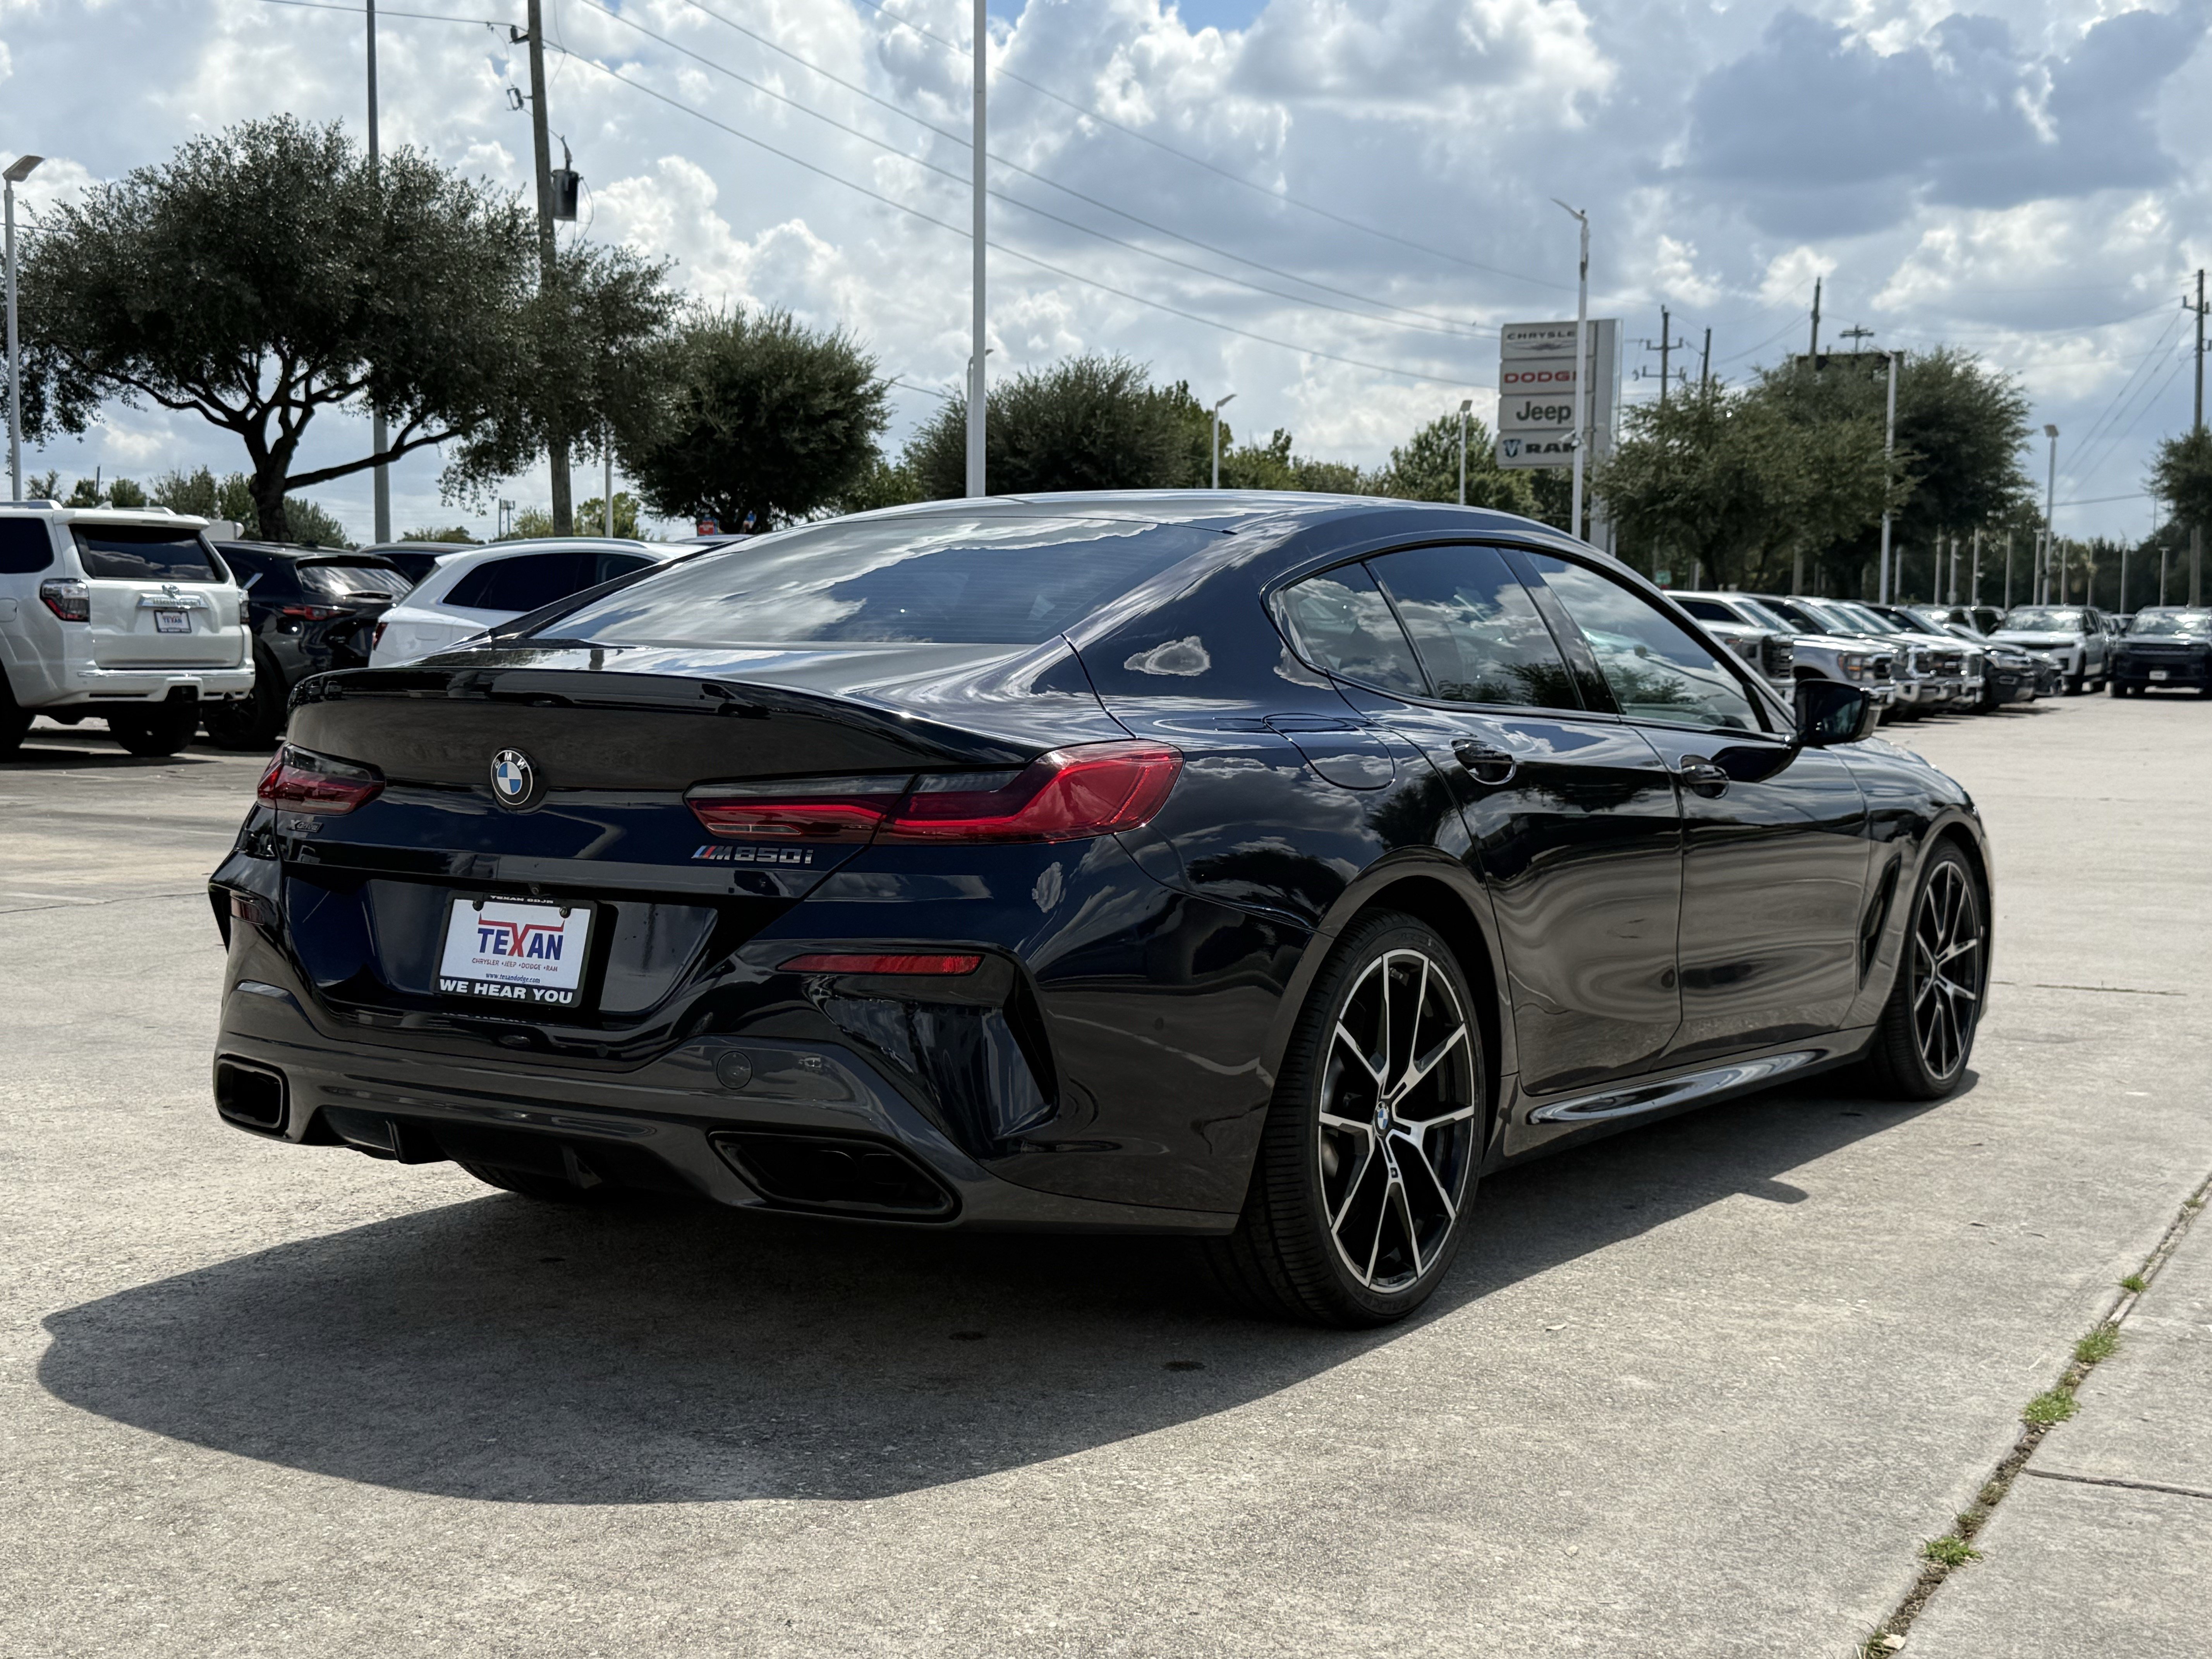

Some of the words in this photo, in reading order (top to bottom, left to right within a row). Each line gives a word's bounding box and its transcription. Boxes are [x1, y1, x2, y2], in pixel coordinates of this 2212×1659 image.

[1507, 331, 1575, 340] CHRYSLE
[1504, 371, 1576, 383] DODG
[1516, 401, 1571, 424] Jeep
[706, 845, 813, 864] M850i
[477, 920, 564, 960] TEXAN
[472, 958, 500, 966] CHRYSLER
[486, 973, 541, 984] www.texandodge.com
[440, 979, 469, 993] WE
[474, 982, 526, 999] HEAR
[532, 988, 573, 1004] YOU
